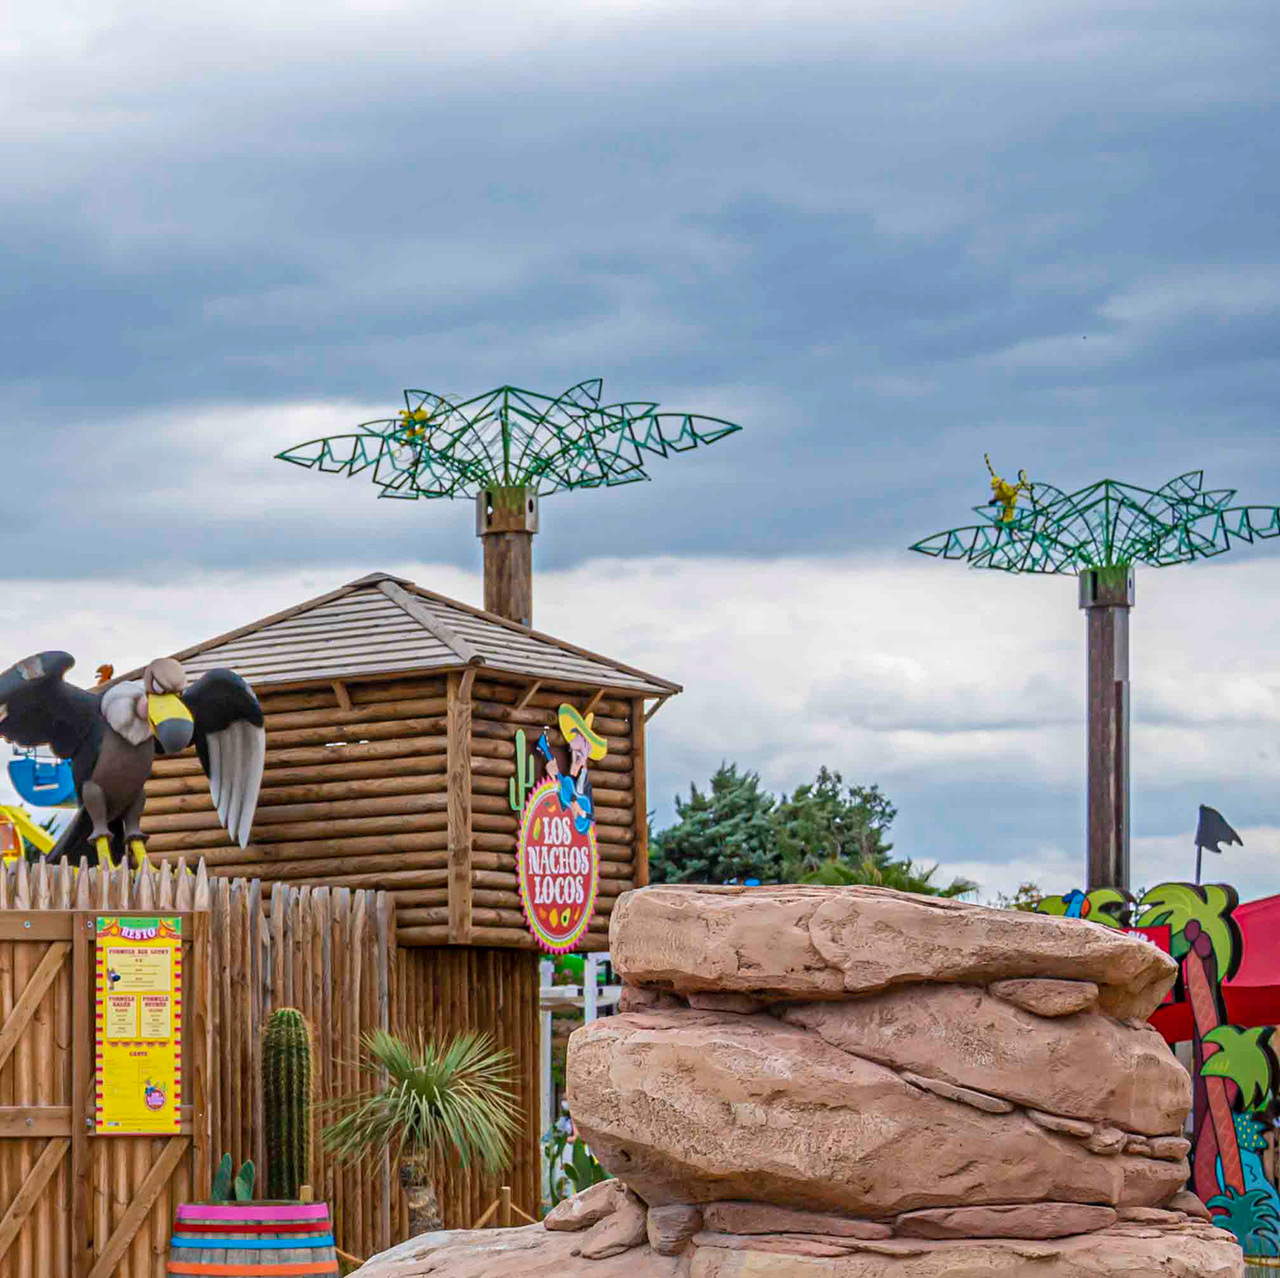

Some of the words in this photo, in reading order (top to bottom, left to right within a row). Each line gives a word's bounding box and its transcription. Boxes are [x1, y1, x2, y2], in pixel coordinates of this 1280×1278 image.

[542, 816, 572, 845] LOS
[527, 845, 590, 875] NACHOS
[533, 875, 584, 904] LOCOS
[121, 926, 157, 940] RESTO
